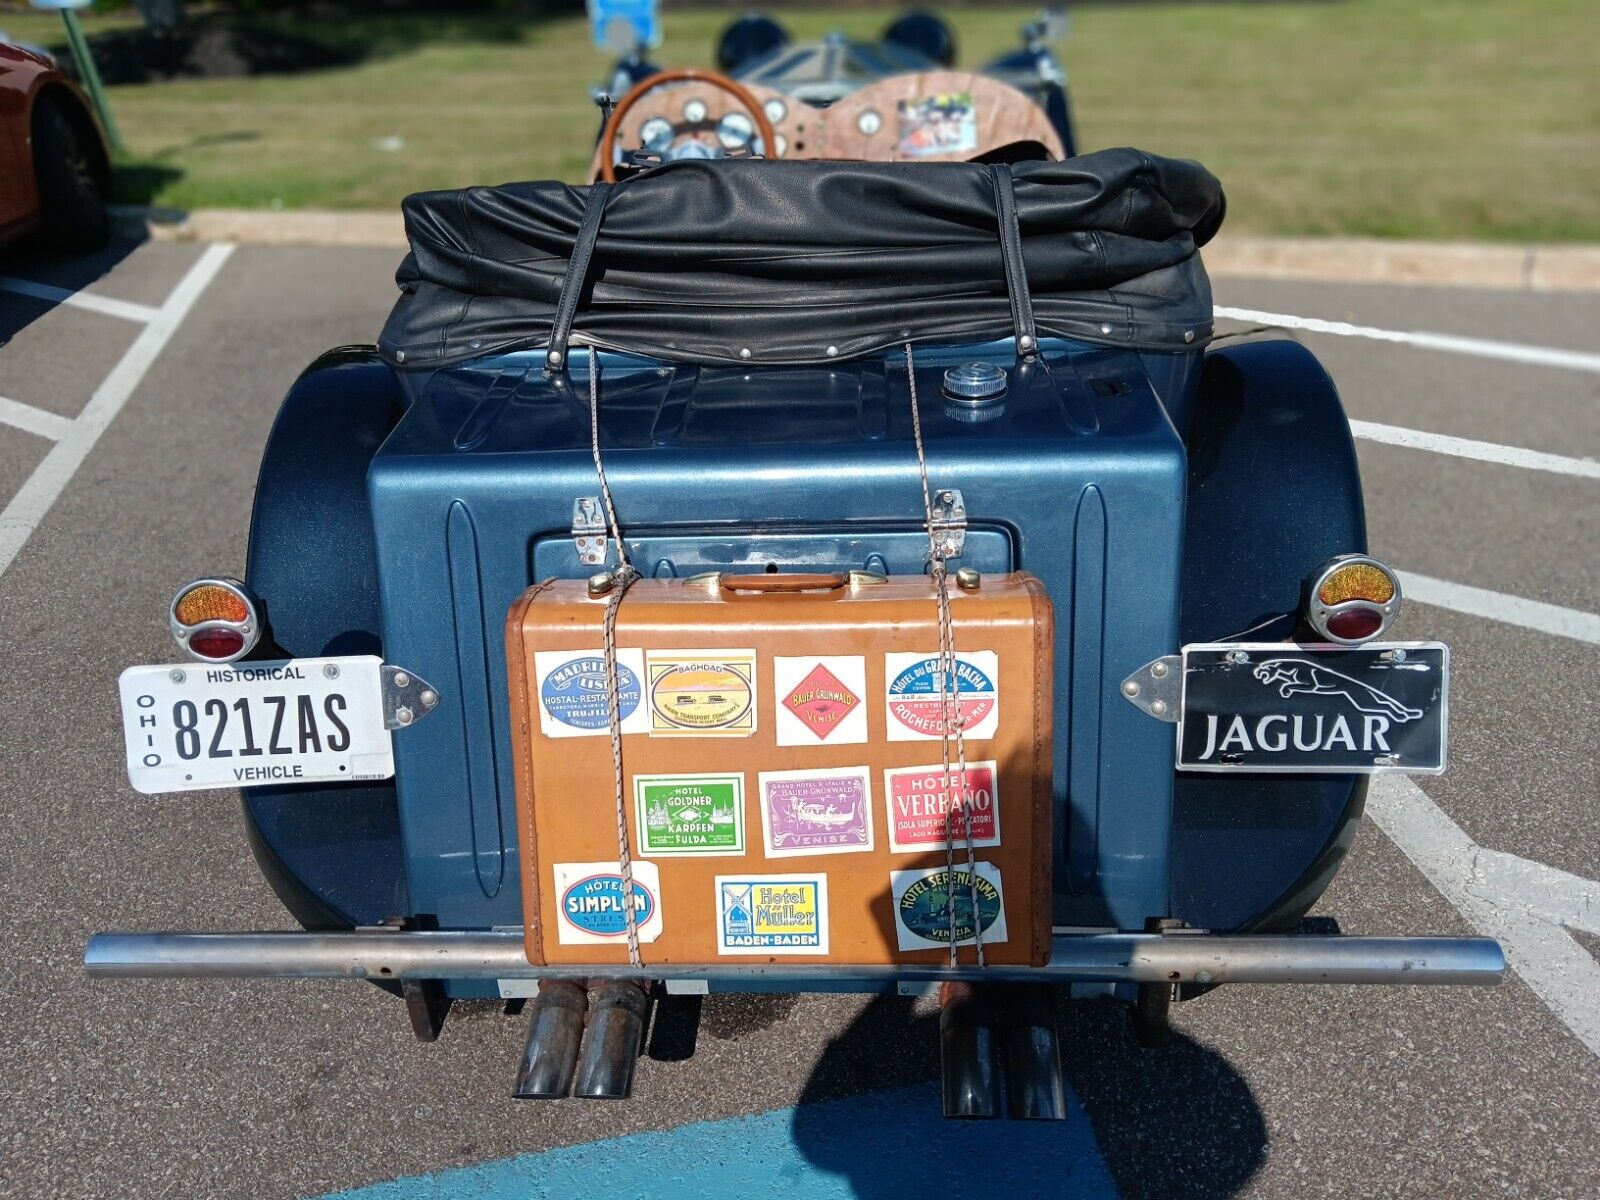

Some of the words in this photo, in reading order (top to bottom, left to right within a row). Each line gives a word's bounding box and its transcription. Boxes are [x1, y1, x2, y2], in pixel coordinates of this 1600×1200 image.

[206, 667, 305, 682] HISTORICAL
[679, 664, 722, 673] BAGHDAD
[914, 667, 925, 677] DU
[925, 659, 955, 673] GRAN
[957, 664, 986, 690] BACHA
[579, 676, 631, 689] LISA
[545, 691, 639, 704] HOSTAL-RESTAANTE
[793, 691, 815, 707] BAUER
[566, 709, 610, 717] TRUJIL
[806, 711, 837, 723] VENISE
[136, 695, 161, 767] OHIO
[172, 693, 351, 760] 821ZAS
[1198, 714, 1391, 760] JAGUAR
[233, 766, 303, 781] VEHICLE
[782, 788, 809, 796] BAUER
[668, 796, 712, 806] GOLDNER
[668, 823, 715, 833] KARPFEN
[917, 817, 954, 828] SUPERIOE
[958, 815, 992, 825] PECATORI
[675, 834, 707, 844] FULDA
[791, 834, 848, 844] VENISE
[584, 878, 624, 893] HÔTEL
[901, 881, 929, 909] HOTEL
[928, 872, 997, 901] SERNISIMA
[760, 887, 806, 904] Hotel
[568, 894, 647, 913] SIMPLN
[583, 915, 625, 923] STRES
[755, 904, 814, 926] Müller
[932, 926, 971, 937] VENZIA
[726, 934, 818, 946] BADEN-BADEN
